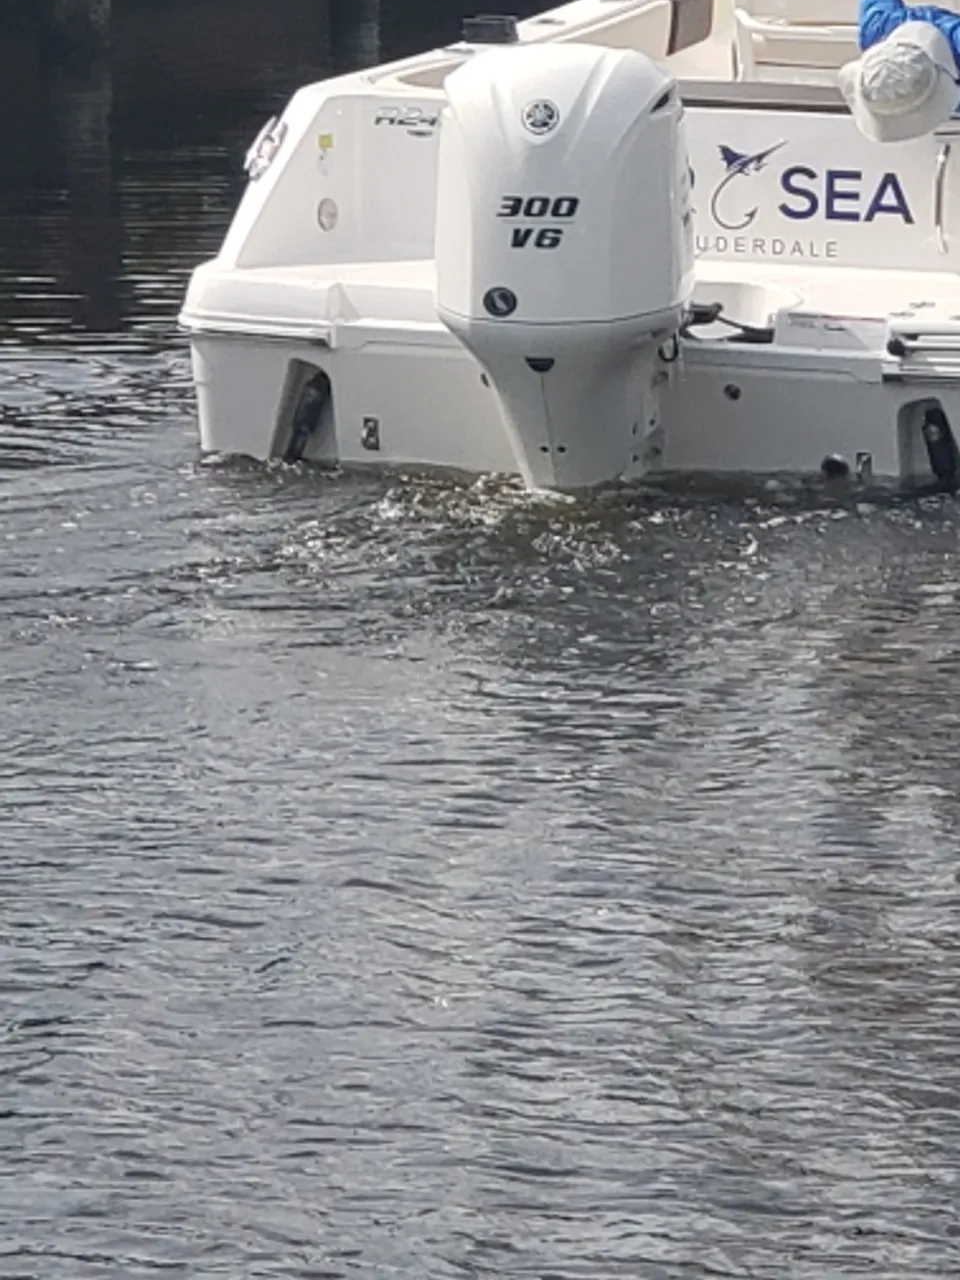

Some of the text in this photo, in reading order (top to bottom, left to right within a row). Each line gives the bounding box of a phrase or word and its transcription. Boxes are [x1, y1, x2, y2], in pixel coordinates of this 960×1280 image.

[777, 165, 915, 224] SEA
[495, 195, 580, 218] 300
[510, 227, 564, 249] V6
